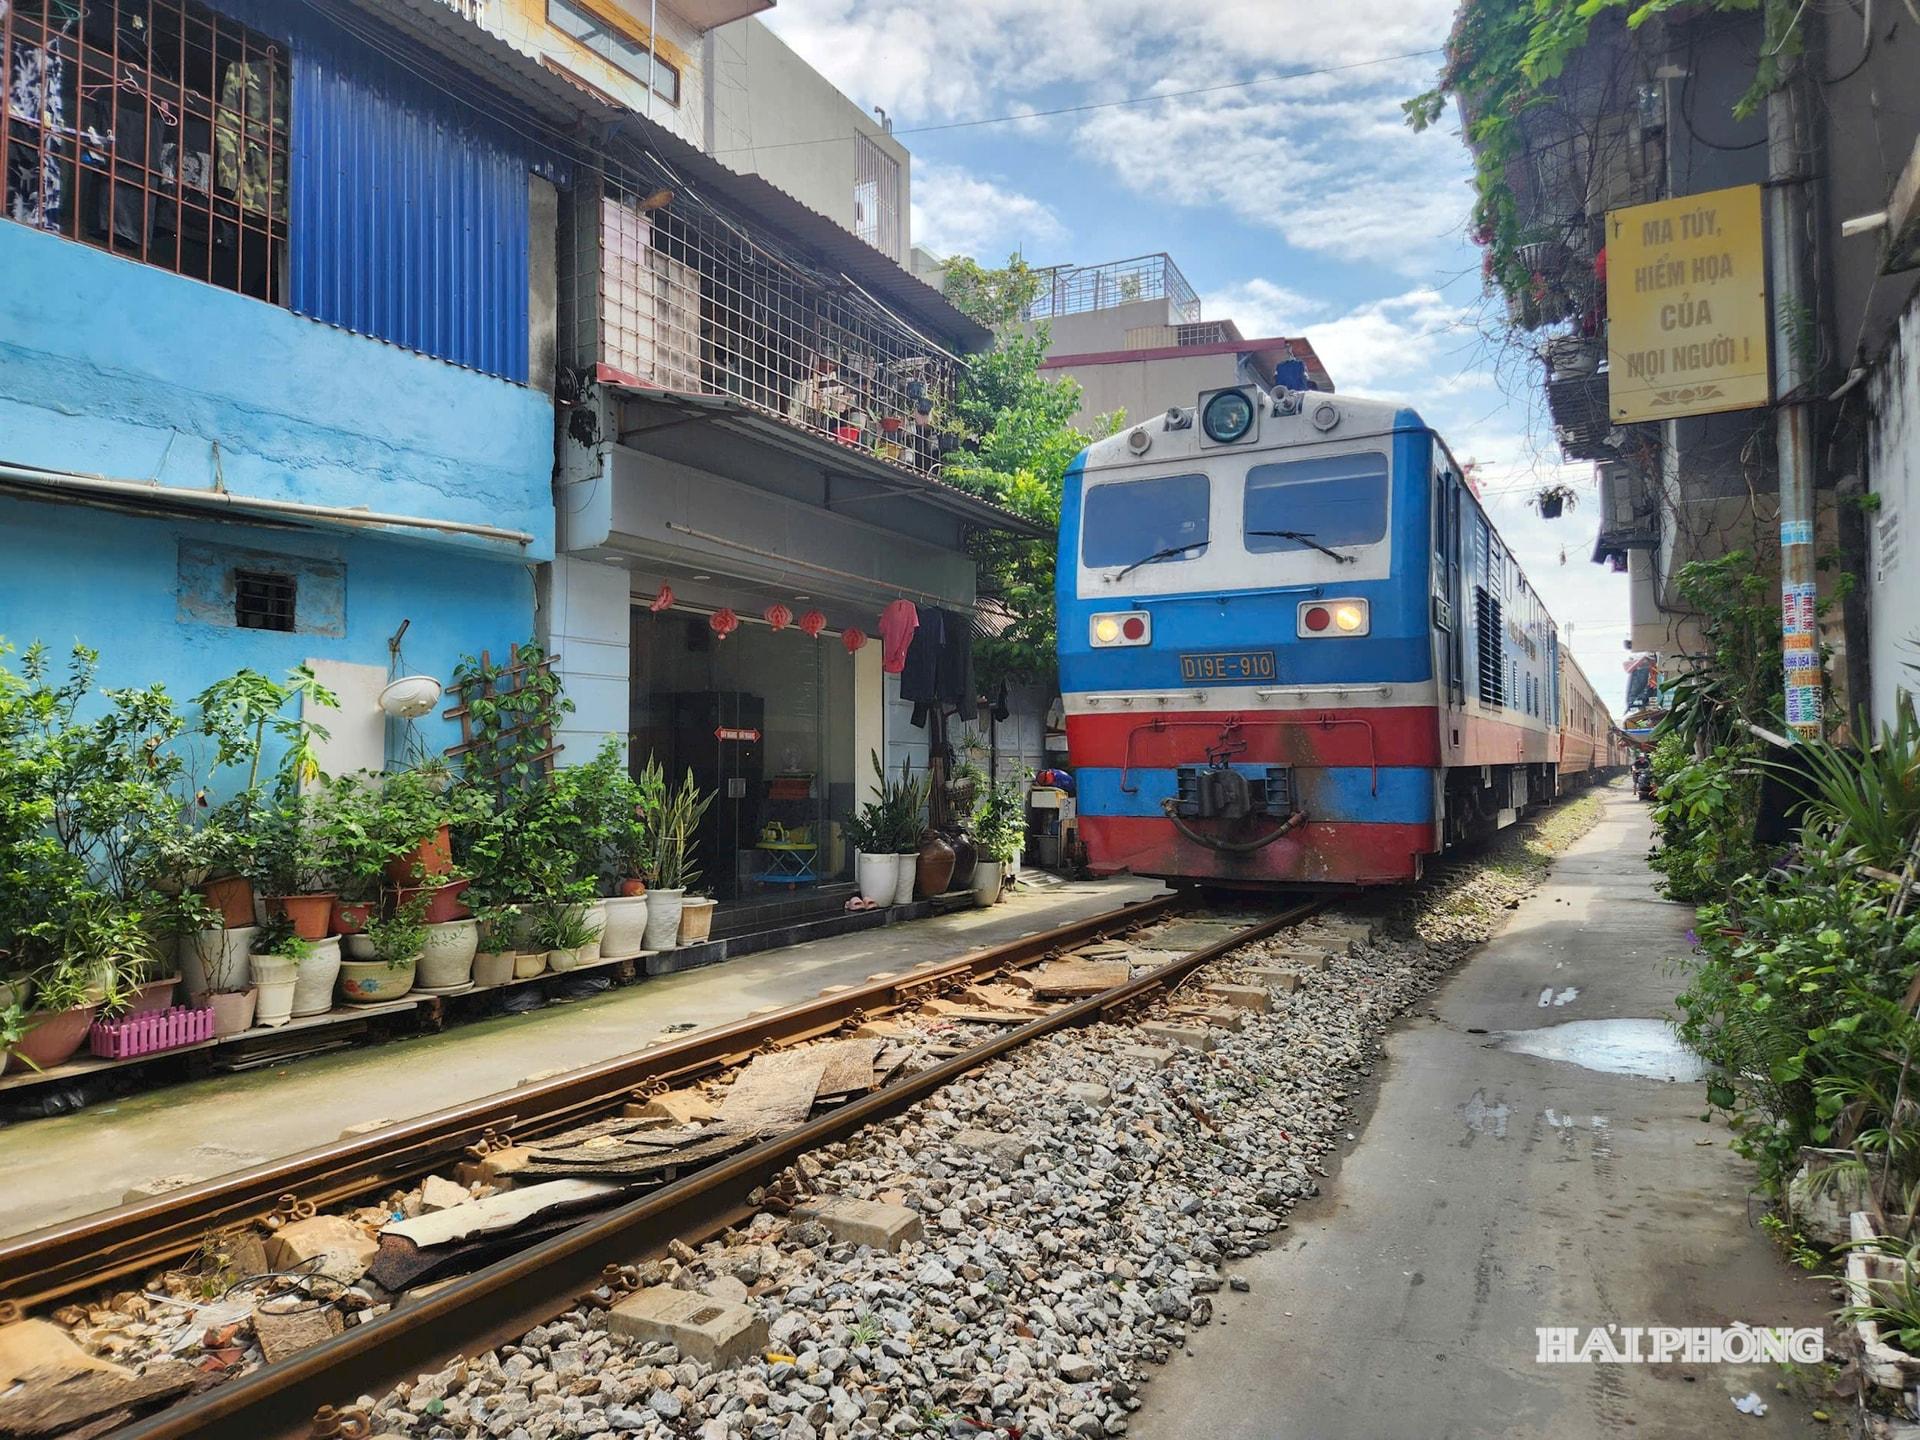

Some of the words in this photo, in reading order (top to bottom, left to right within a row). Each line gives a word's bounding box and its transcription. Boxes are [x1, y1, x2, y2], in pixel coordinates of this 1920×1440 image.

[1642, 218, 1673, 247] MA
[1680, 206, 1722, 241] TÚY,
[1692, 252, 1733, 286] HỌA
[1660, 292, 1713, 332] CỦA
[1627, 349, 1665, 382] MỌI
[1672, 333, 1736, 372] NGƯỜI
[1183, 655, 1271, 678] D19E-910
